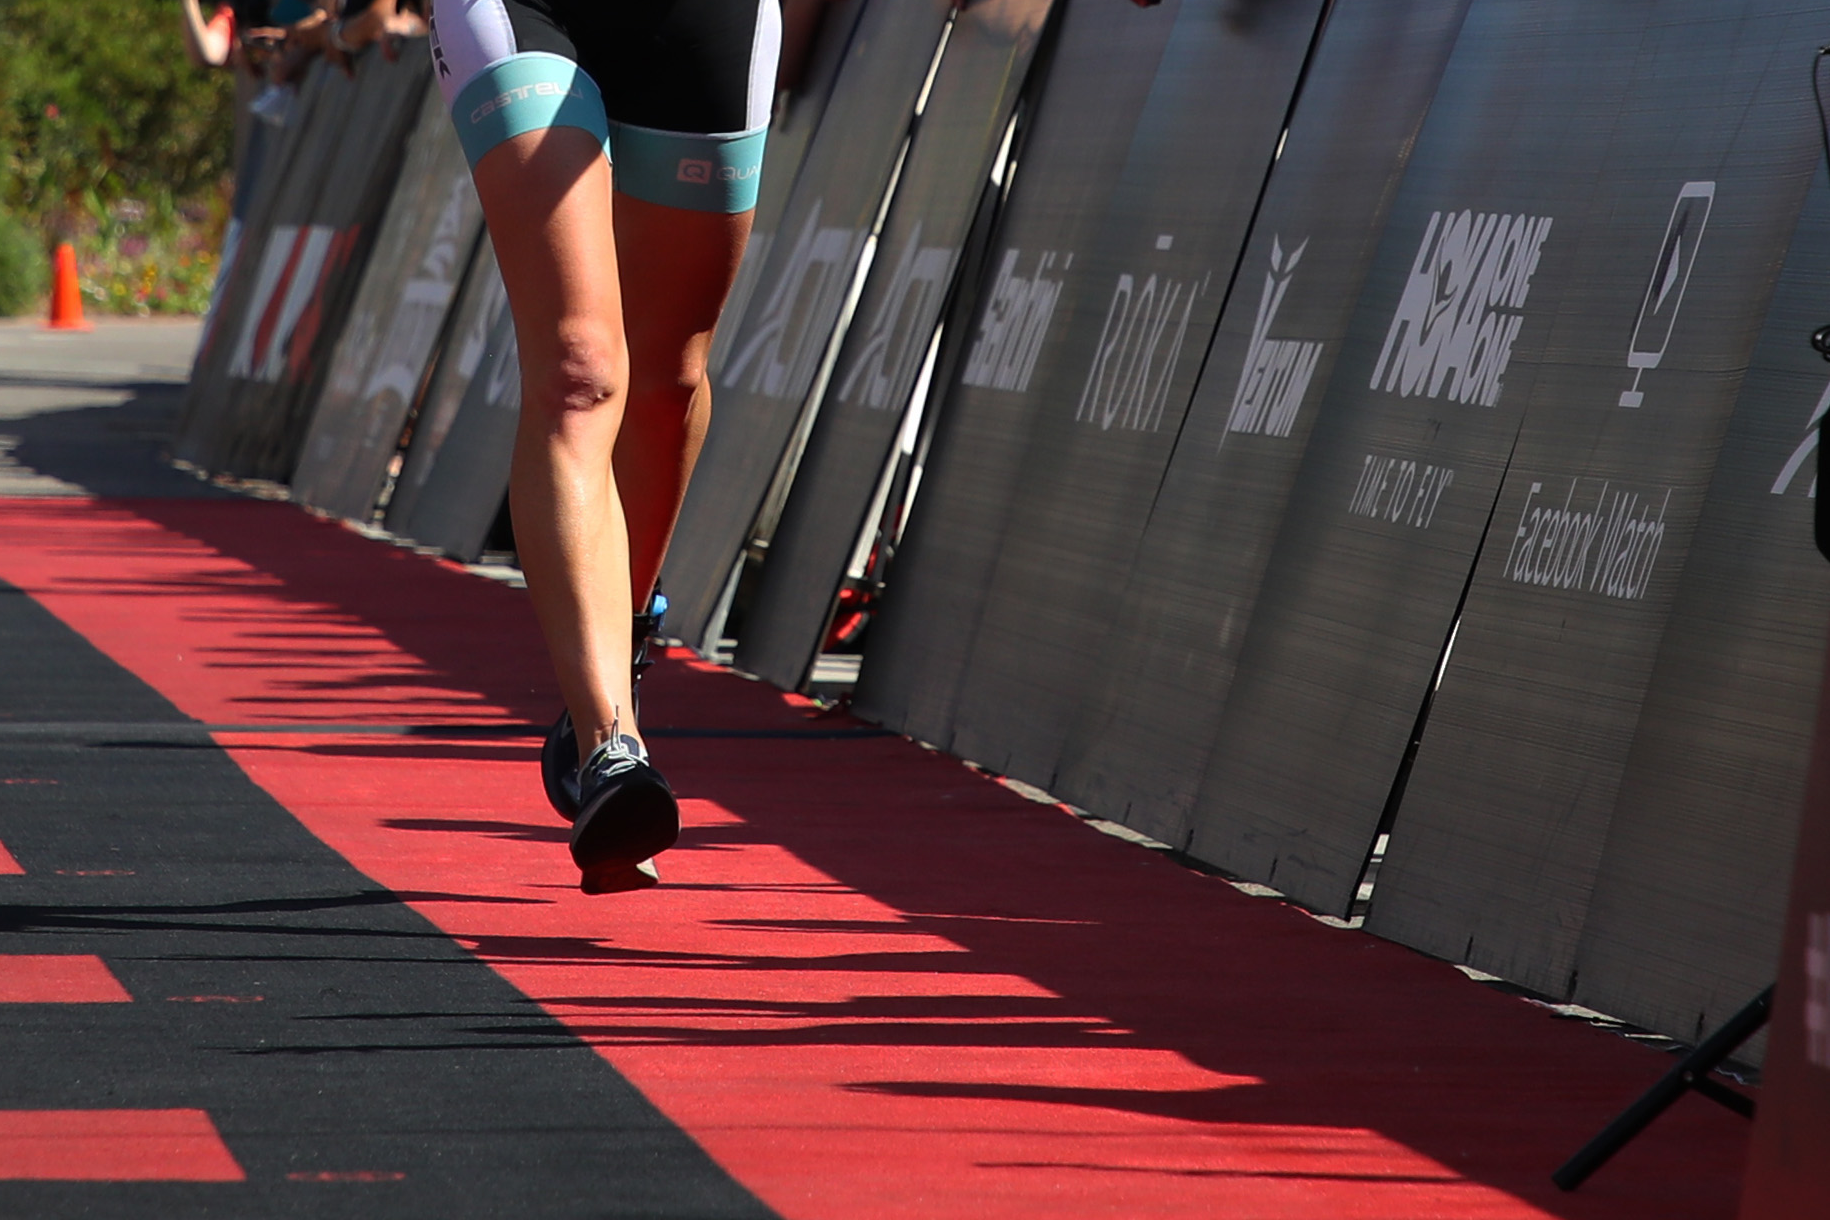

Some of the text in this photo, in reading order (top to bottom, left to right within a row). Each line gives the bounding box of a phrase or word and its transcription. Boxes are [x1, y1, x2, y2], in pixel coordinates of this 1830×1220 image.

[1369, 209, 1555, 402] HOKA ONE
[1460, 311, 1525, 408] ONE
[1348, 454, 1396, 518] TIME
[1383, 460, 1417, 524] TO
[1503, 477, 1673, 601] Facebook Watch
